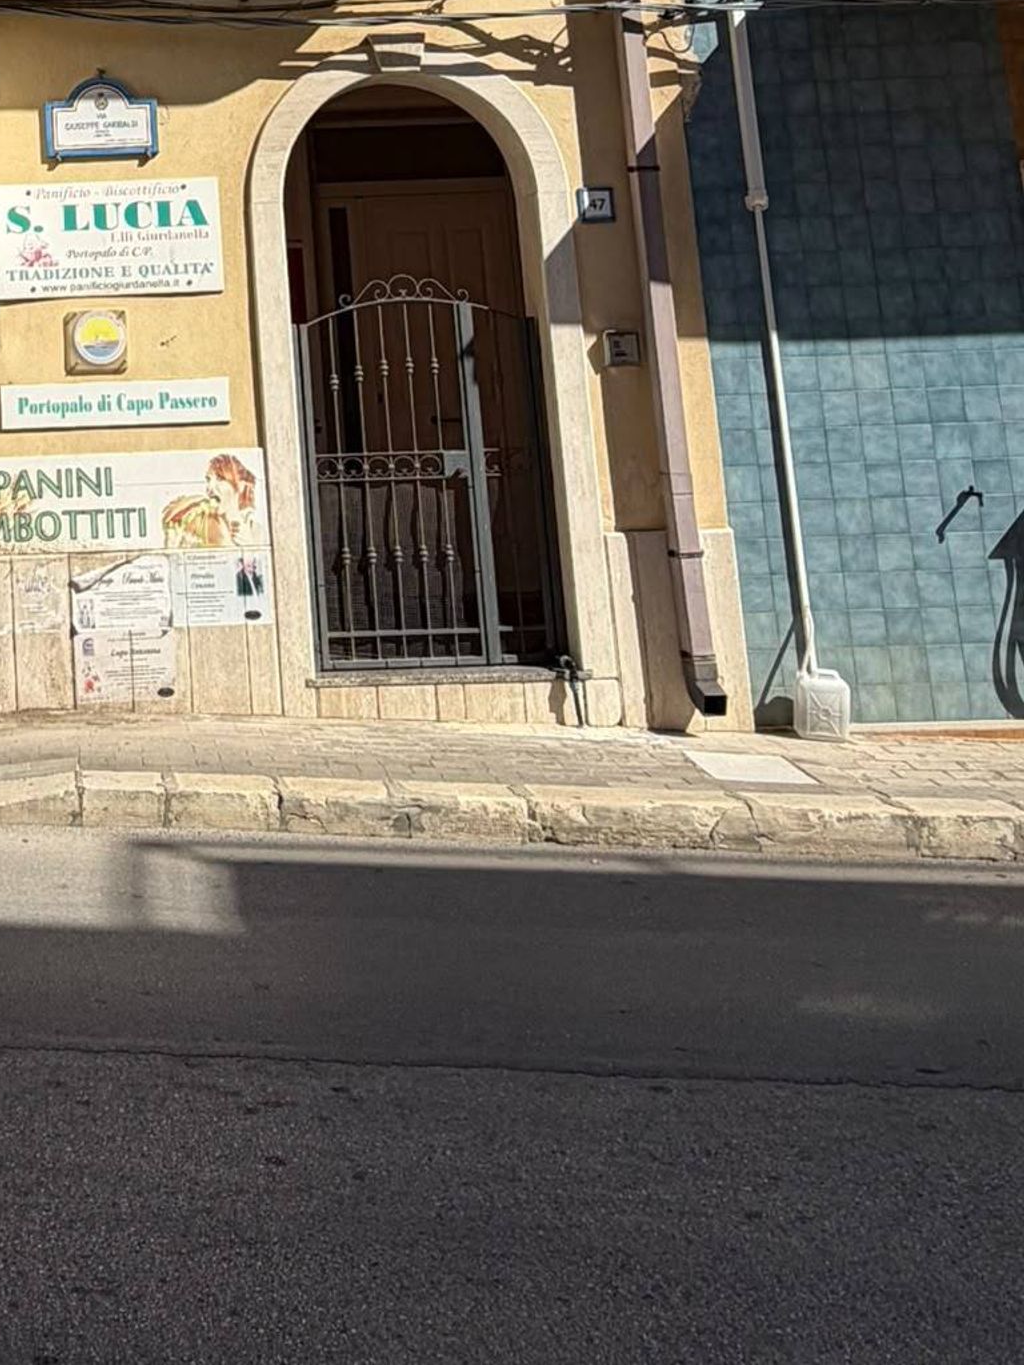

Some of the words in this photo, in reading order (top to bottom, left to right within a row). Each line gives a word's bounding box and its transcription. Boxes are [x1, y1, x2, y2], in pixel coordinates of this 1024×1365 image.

[35, 187, 91, 203] Panificio
[105, 182, 181, 198] Biscottificio
[589, 198, 607, 212] 47
[6, 205, 44, 235] S.
[61, 199, 209, 232] LUCIA
[66, 247, 117, 262] Portopalo
[119, 246, 130, 258] di
[6, 265, 116, 283] TRADIZIONE
[120, 265, 132, 277] E
[17, 395, 93, 419] Portopalo
[97, 394, 112, 413] di
[116, 392, 154, 416] Capo
[159, 391, 218, 411] Passero
